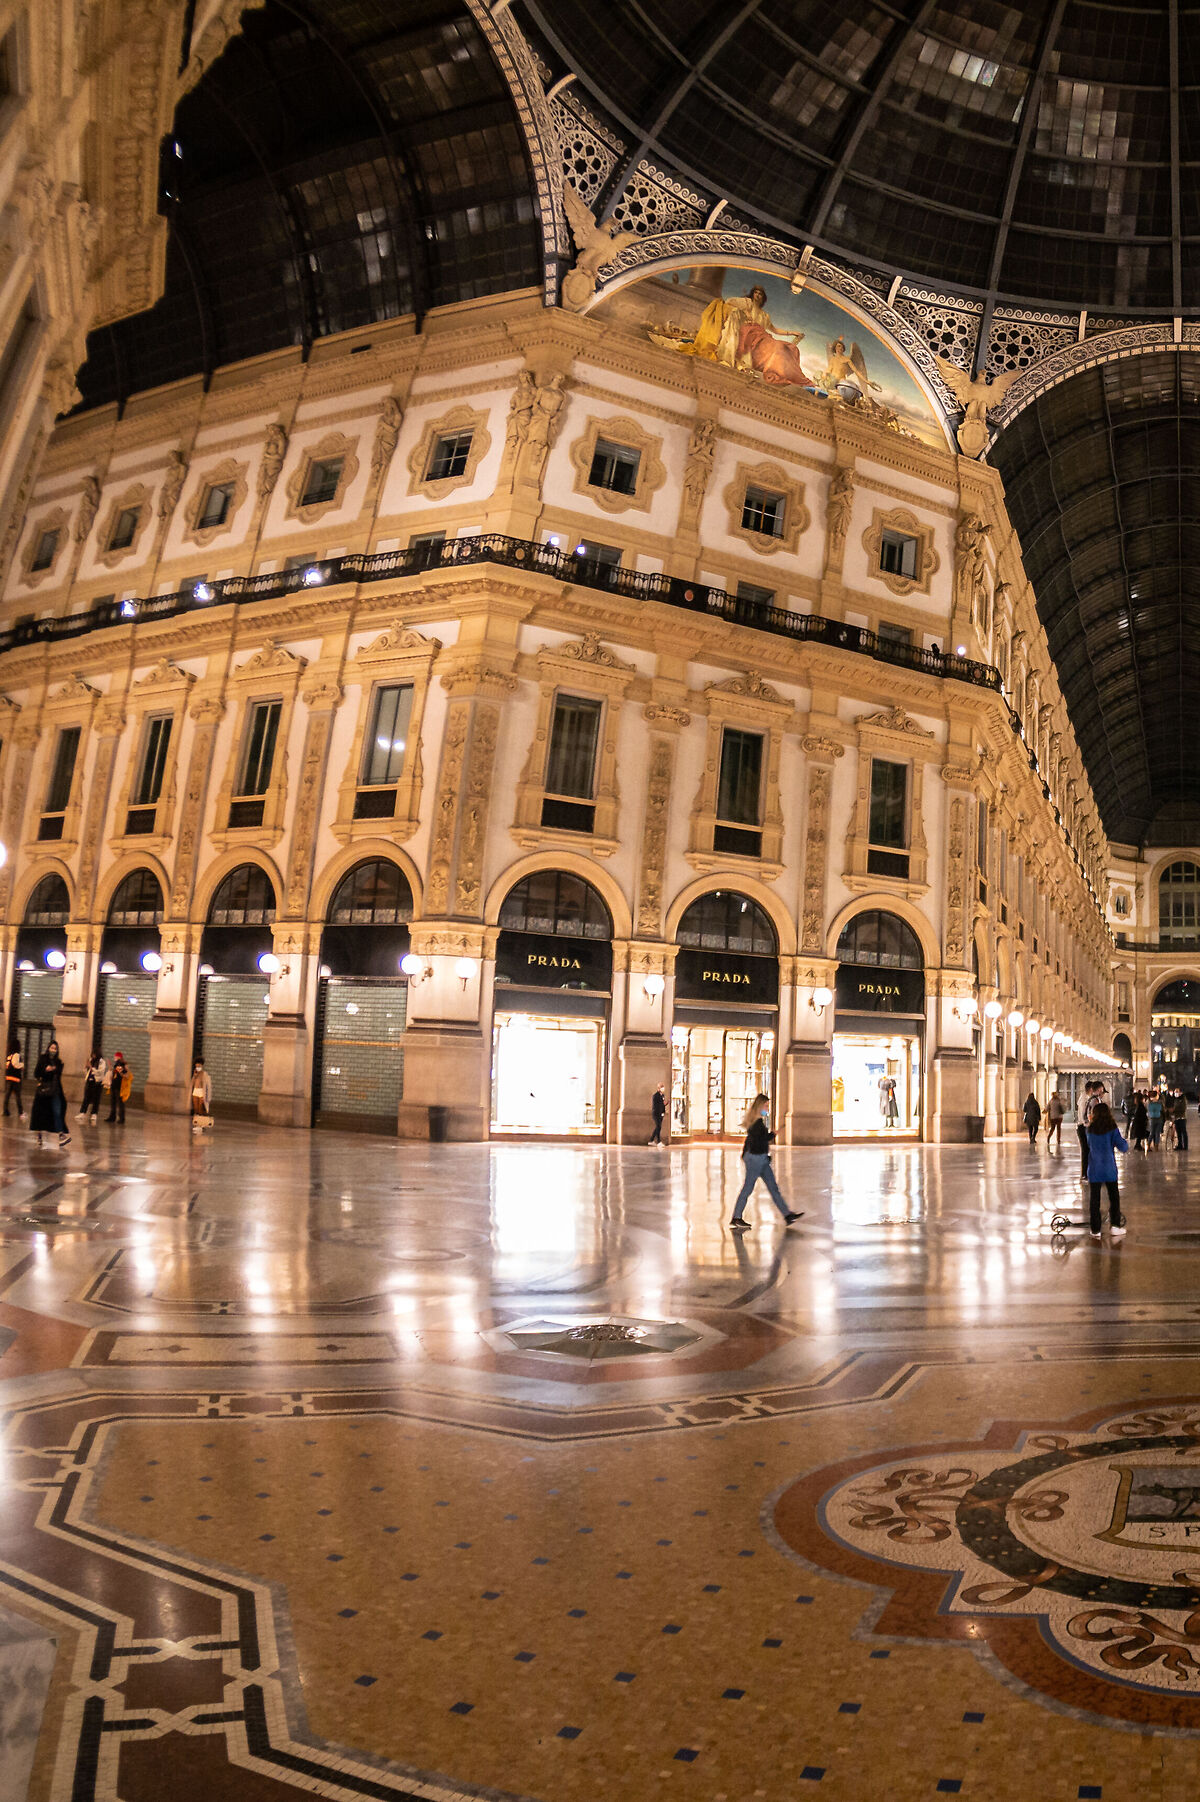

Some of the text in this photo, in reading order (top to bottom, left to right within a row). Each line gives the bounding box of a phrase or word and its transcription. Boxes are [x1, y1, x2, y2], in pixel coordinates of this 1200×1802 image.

[527, 954, 582, 969] PRADA
[702, 971, 751, 985] PRADA
[858, 983, 901, 996] PRADA
